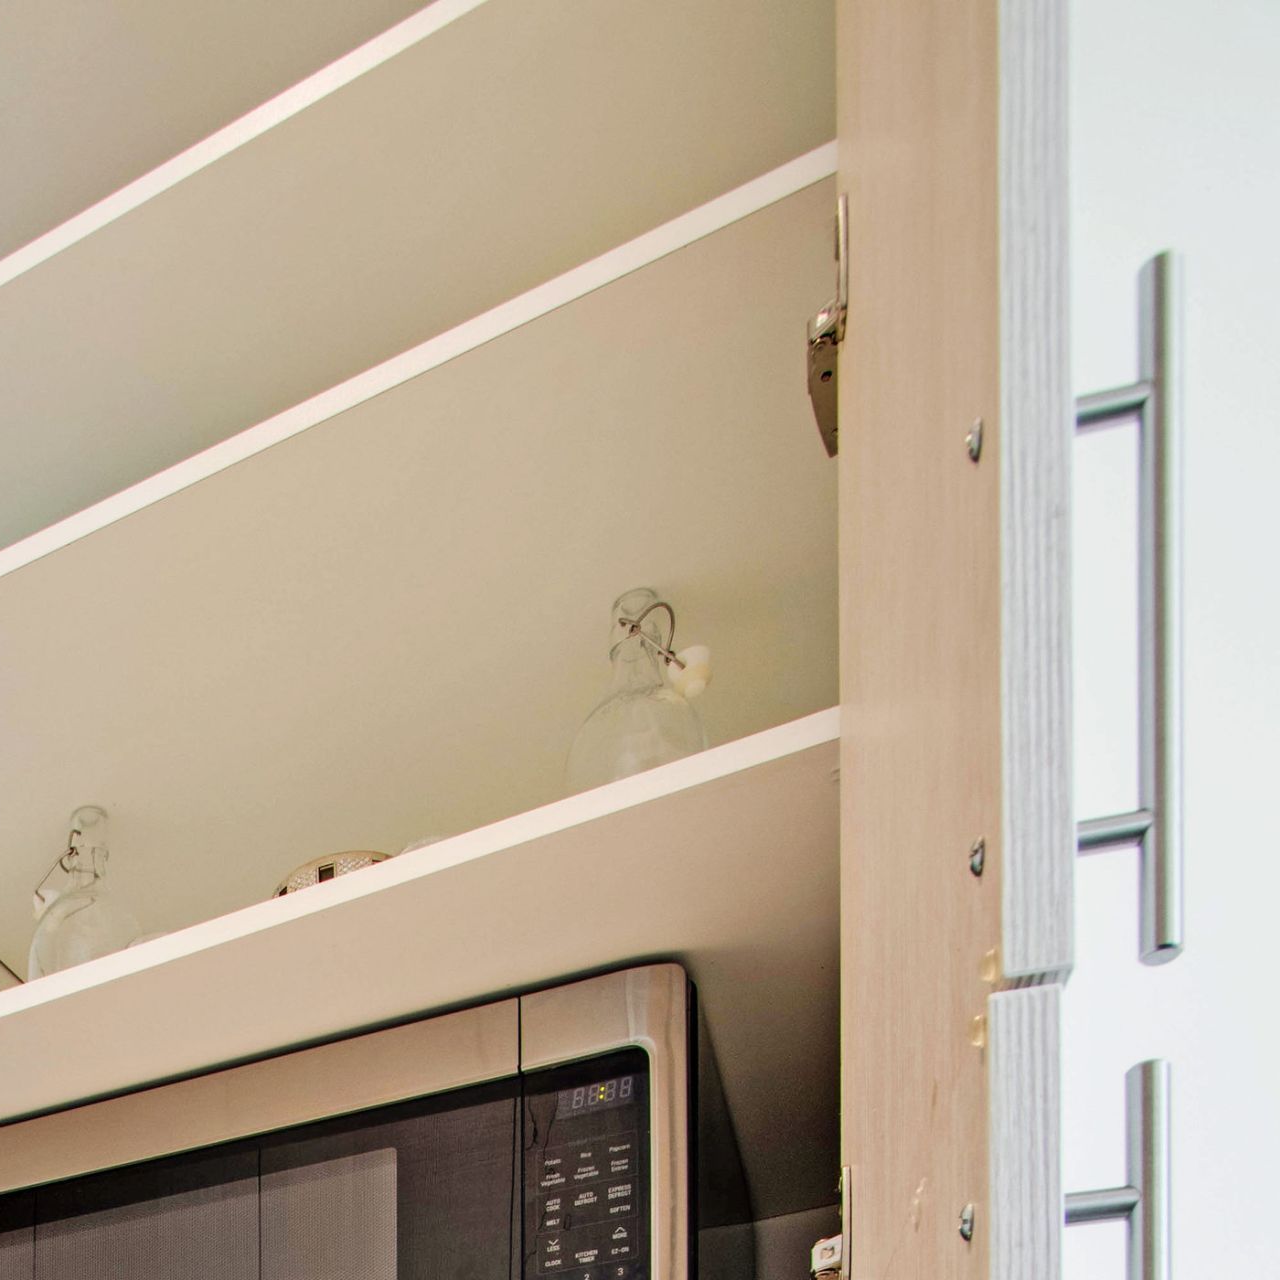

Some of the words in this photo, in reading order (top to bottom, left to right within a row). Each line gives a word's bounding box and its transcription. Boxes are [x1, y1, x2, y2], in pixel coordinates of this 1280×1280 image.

[608, 1190, 631, 1199] DEFROST
[574, 1196, 597, 1206] DEFROST
[610, 1205, 630, 1214] SOFTEN
[575, 1250, 598, 1258] KITCHEN
[617, 1268, 623, 1276] 3
